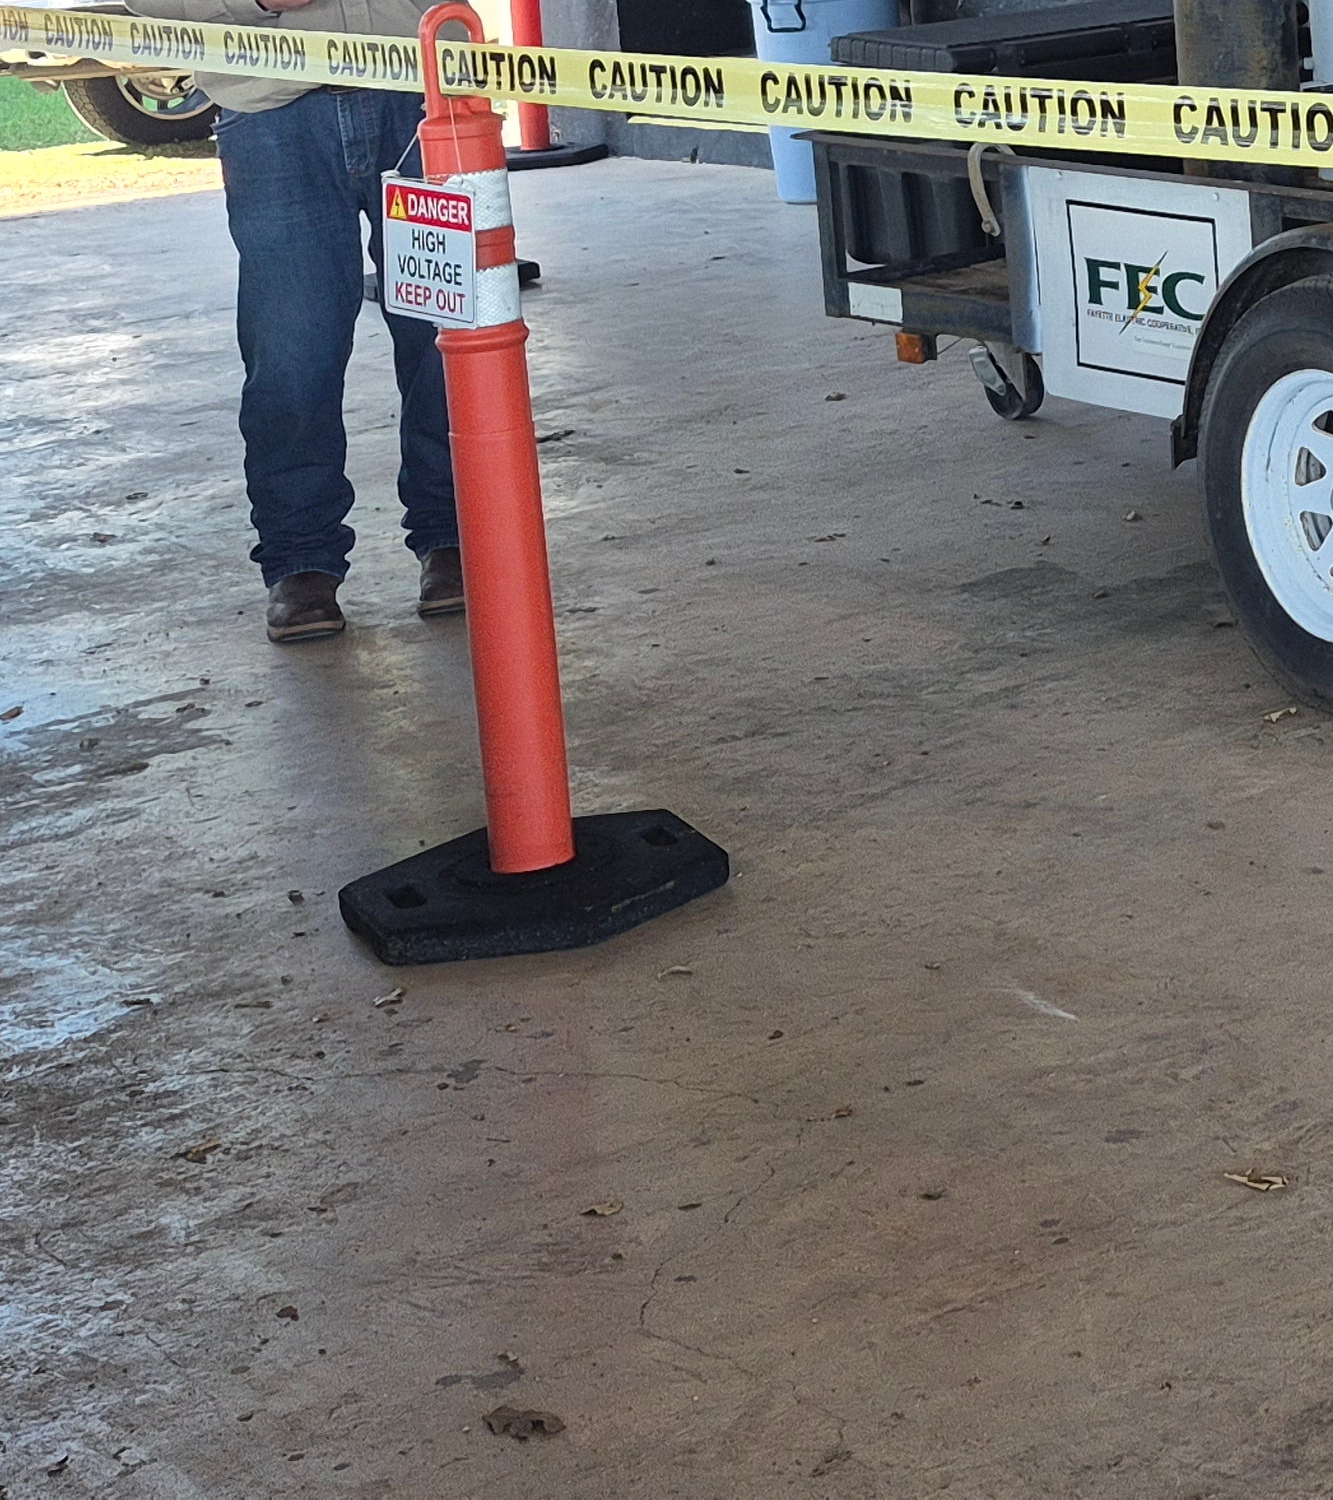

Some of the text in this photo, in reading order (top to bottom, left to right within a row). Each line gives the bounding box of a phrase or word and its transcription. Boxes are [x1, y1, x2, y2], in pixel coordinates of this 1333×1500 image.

[44, 14, 113, 52] CAUTION
[130, 22, 205, 61] CAUTION
[224, 30, 306, 71] CAUTION
[327, 39, 418, 82] CAUTION
[441, 47, 557, 94] CAUTION
[589, 59, 724, 108] CAUTION
[761, 71, 913, 124] CAUTION
[953, 82, 1126, 138] CAUTION
[407, 193, 469, 226] DANGER
[411, 228, 446, 255] HIGH
[397, 253, 463, 286] VOLTAGE
[395, 281, 466, 315] KEEP OUT
[1084, 257, 1206, 321] FEC
